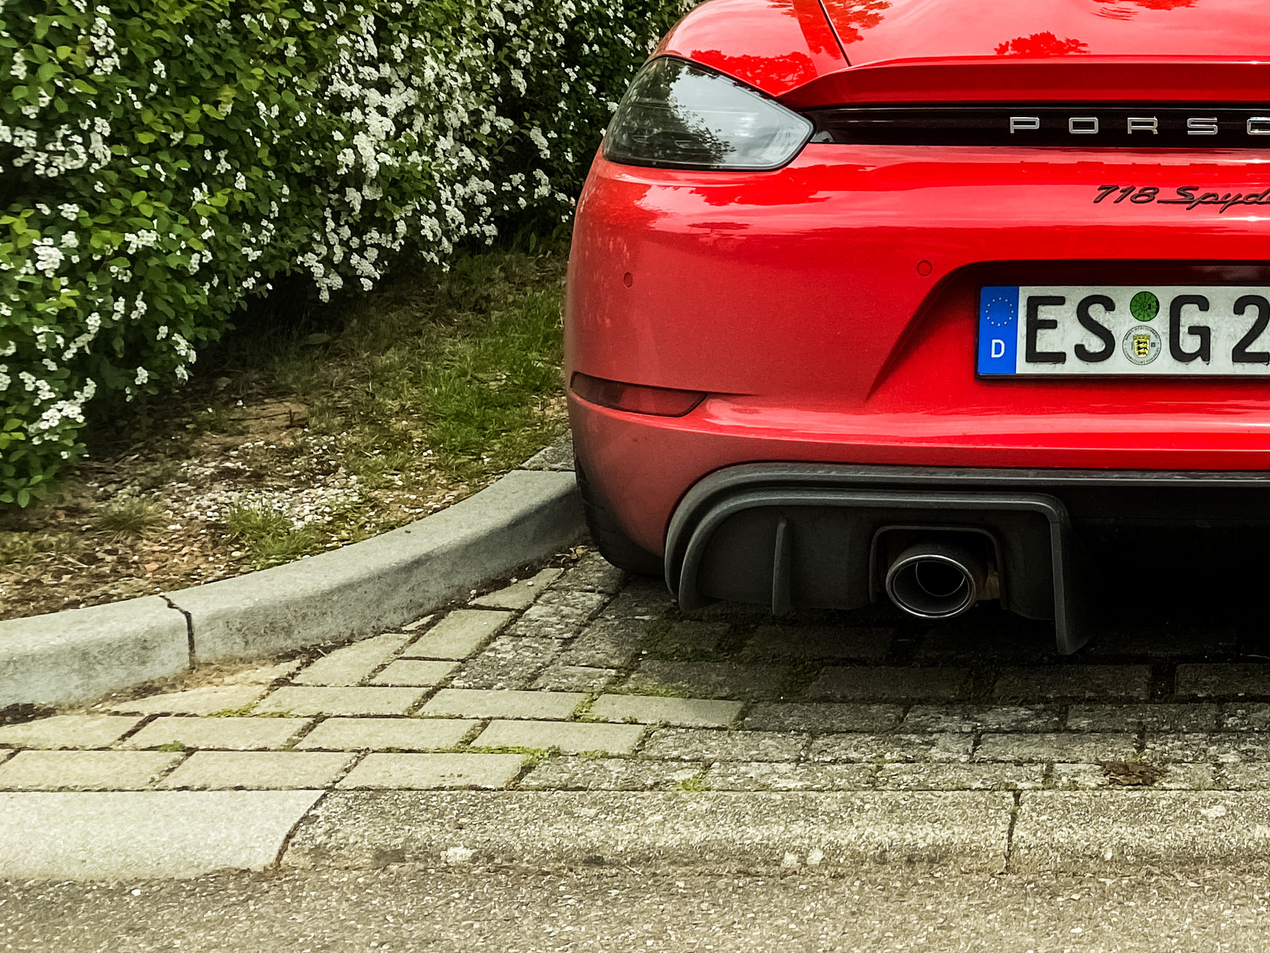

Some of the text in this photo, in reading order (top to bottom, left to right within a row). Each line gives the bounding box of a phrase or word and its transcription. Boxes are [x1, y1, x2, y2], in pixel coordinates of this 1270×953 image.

[1093, 185, 1161, 204] 718
[1025, 295, 1116, 364] ES
[1169, 295, 1211, 364] G
[991, 339, 1006, 358] D
